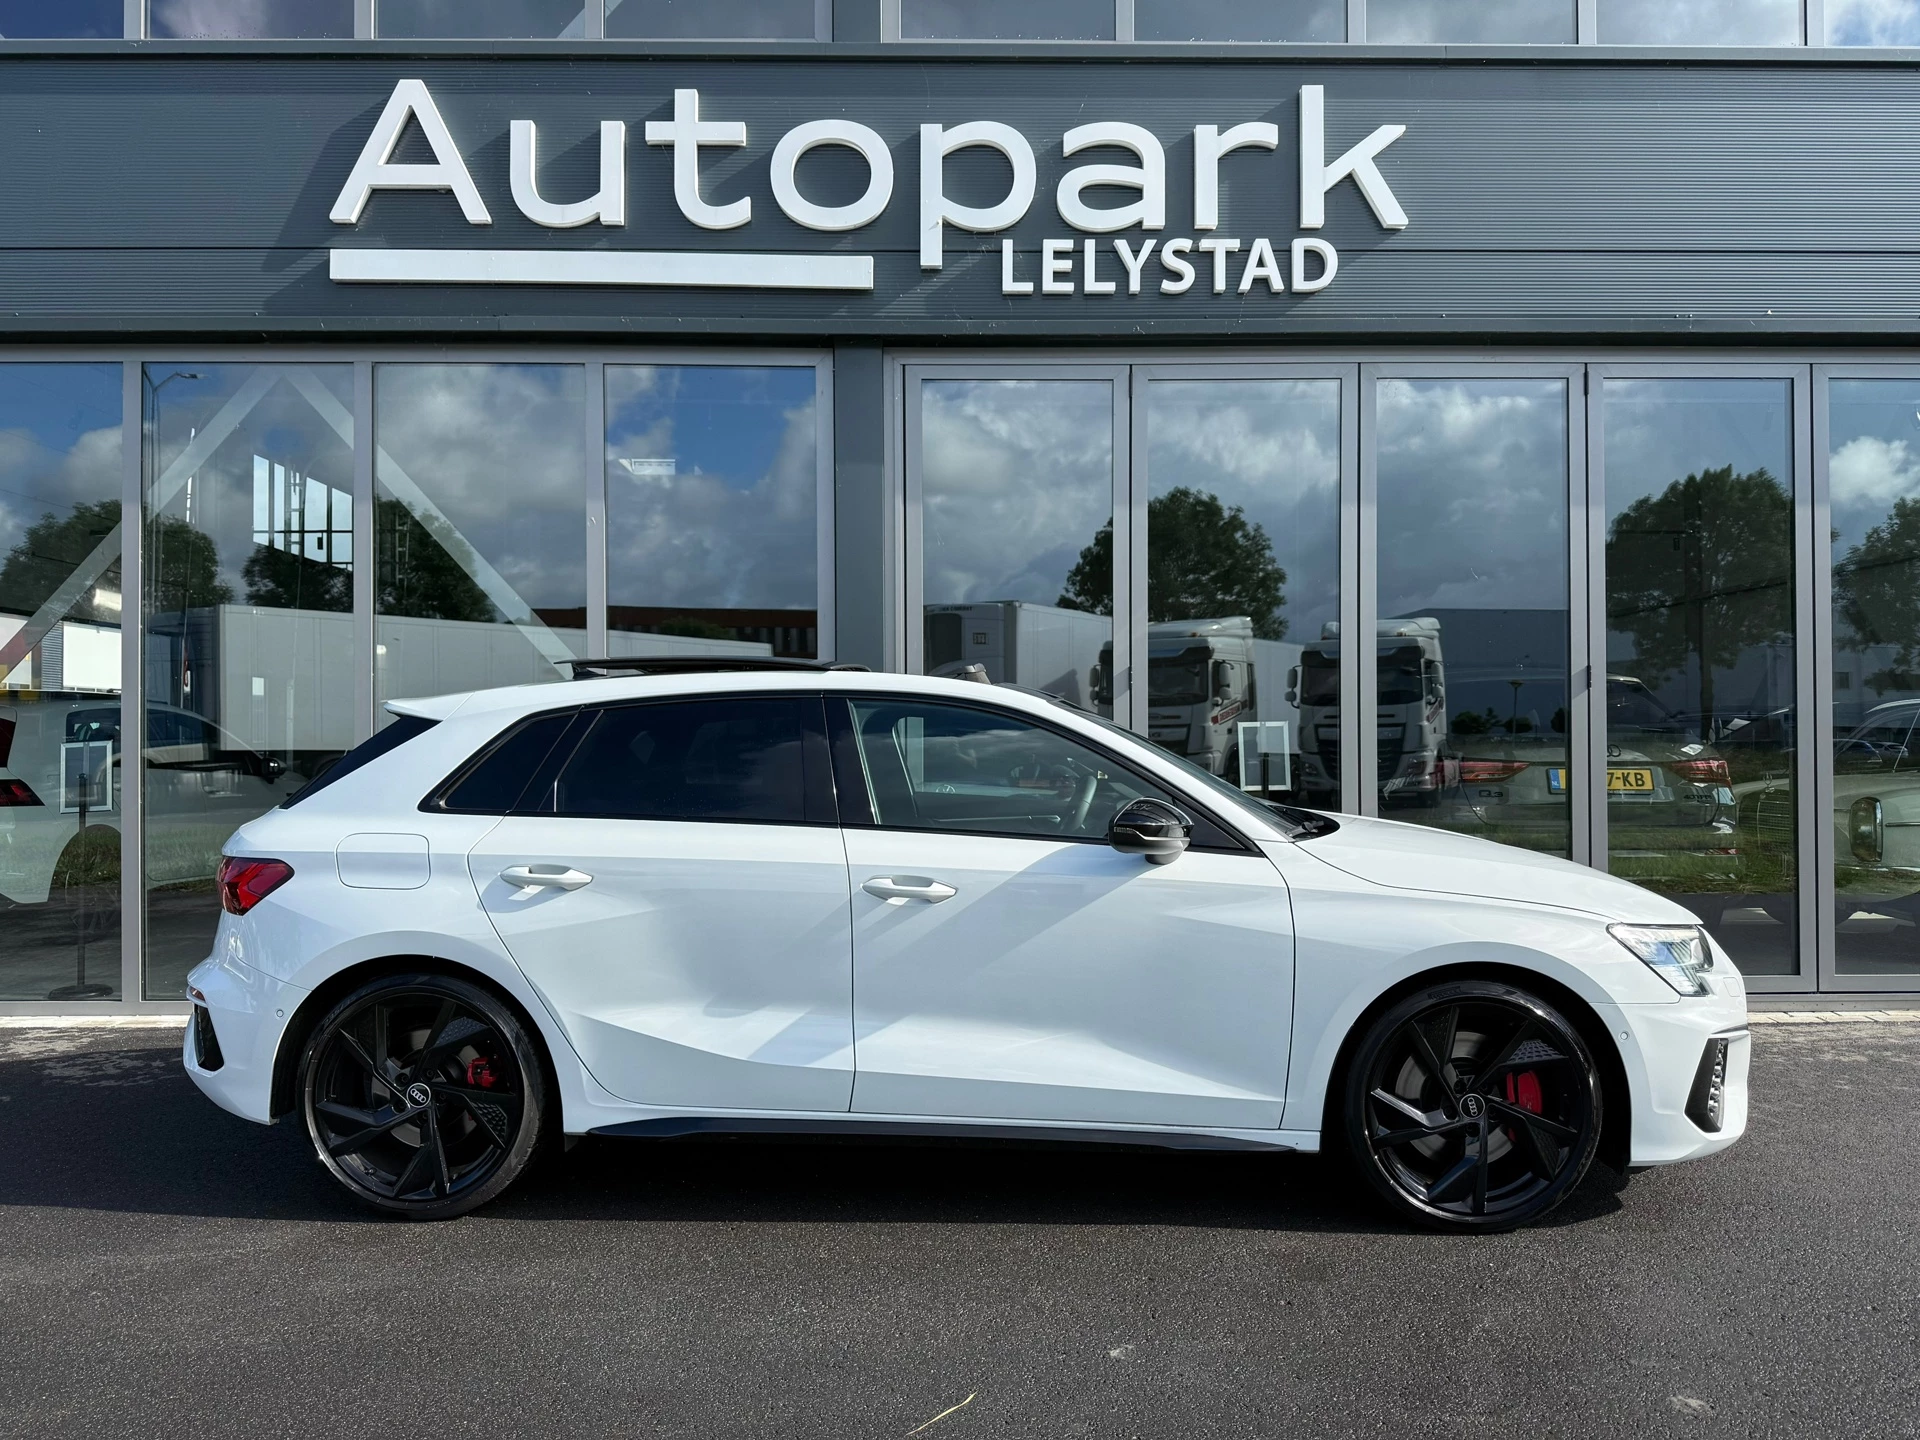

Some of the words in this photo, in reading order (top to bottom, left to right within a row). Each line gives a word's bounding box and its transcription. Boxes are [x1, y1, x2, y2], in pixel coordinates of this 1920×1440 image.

[329, 79, 1410, 270] Autopark
[1001, 238, 1338, 295] LELYSTAD
[1479, 789, 1503, 798] Q3
